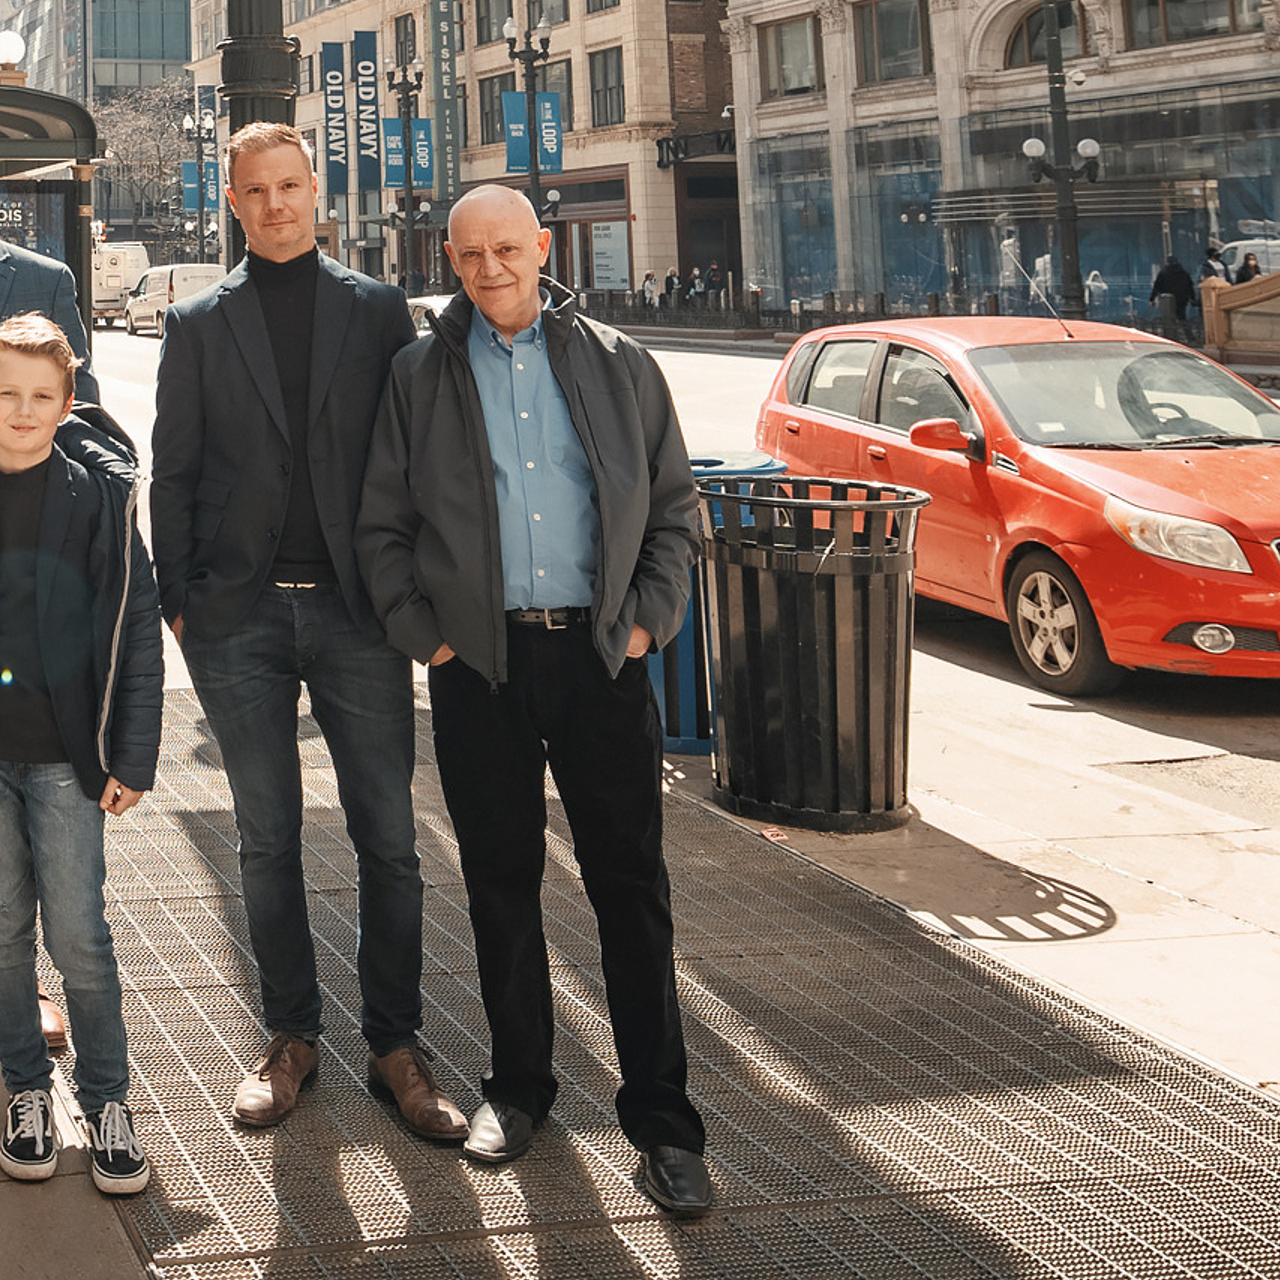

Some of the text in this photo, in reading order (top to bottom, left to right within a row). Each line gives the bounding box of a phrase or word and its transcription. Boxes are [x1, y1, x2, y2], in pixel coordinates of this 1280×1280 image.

[440, 21, 451, 99] SISKEL
[326, 71, 346, 165] OLD NAVY
[357, 60, 378, 159] OLD NAVY
[445, 109, 453, 140] FILM
[416, 141, 429, 169] LOOP
[542, 122, 557, 153] LOOP
[446, 146, 454, 193] CENTER
